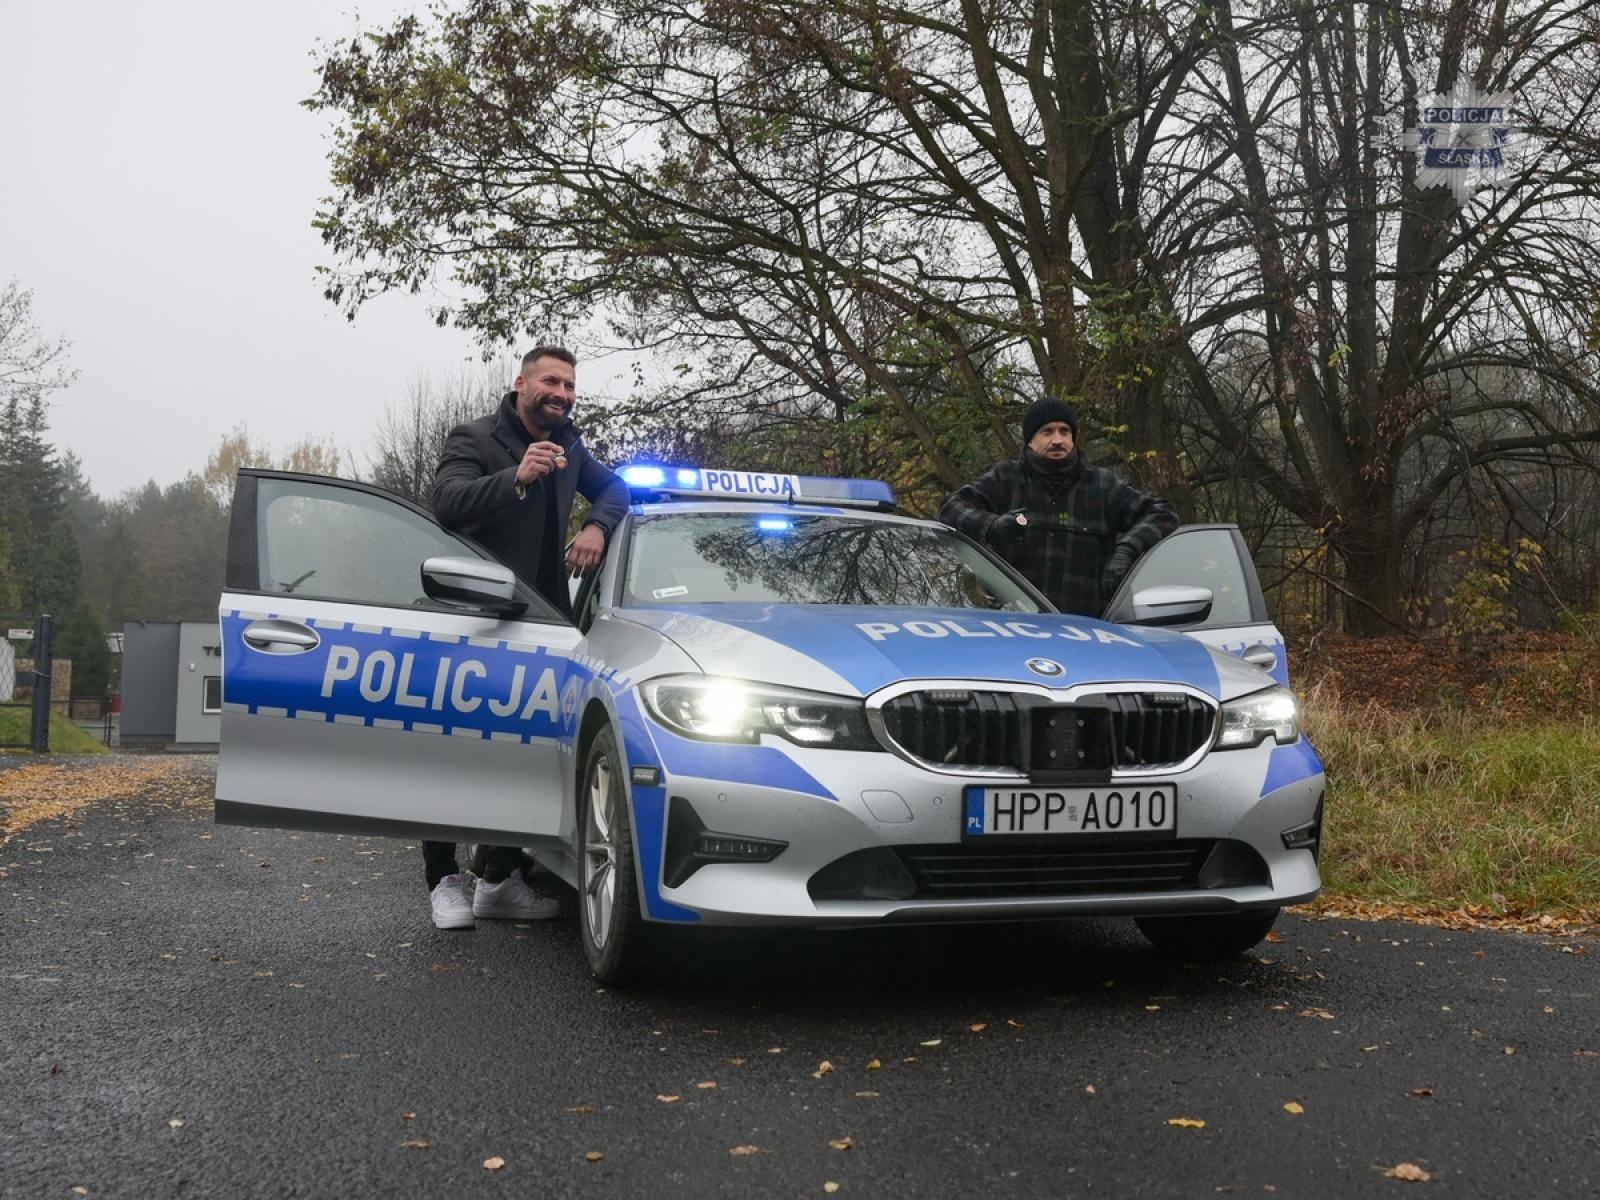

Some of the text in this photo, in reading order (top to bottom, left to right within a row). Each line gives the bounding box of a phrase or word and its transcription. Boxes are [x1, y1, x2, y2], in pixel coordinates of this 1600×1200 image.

[706, 471, 796, 496] POLICJA
[855, 620, 1145, 648] POLICJA
[321, 645, 559, 722] POLICJA
[968, 816, 982, 828] PL
[993, 791, 1166, 831] HPP A010
